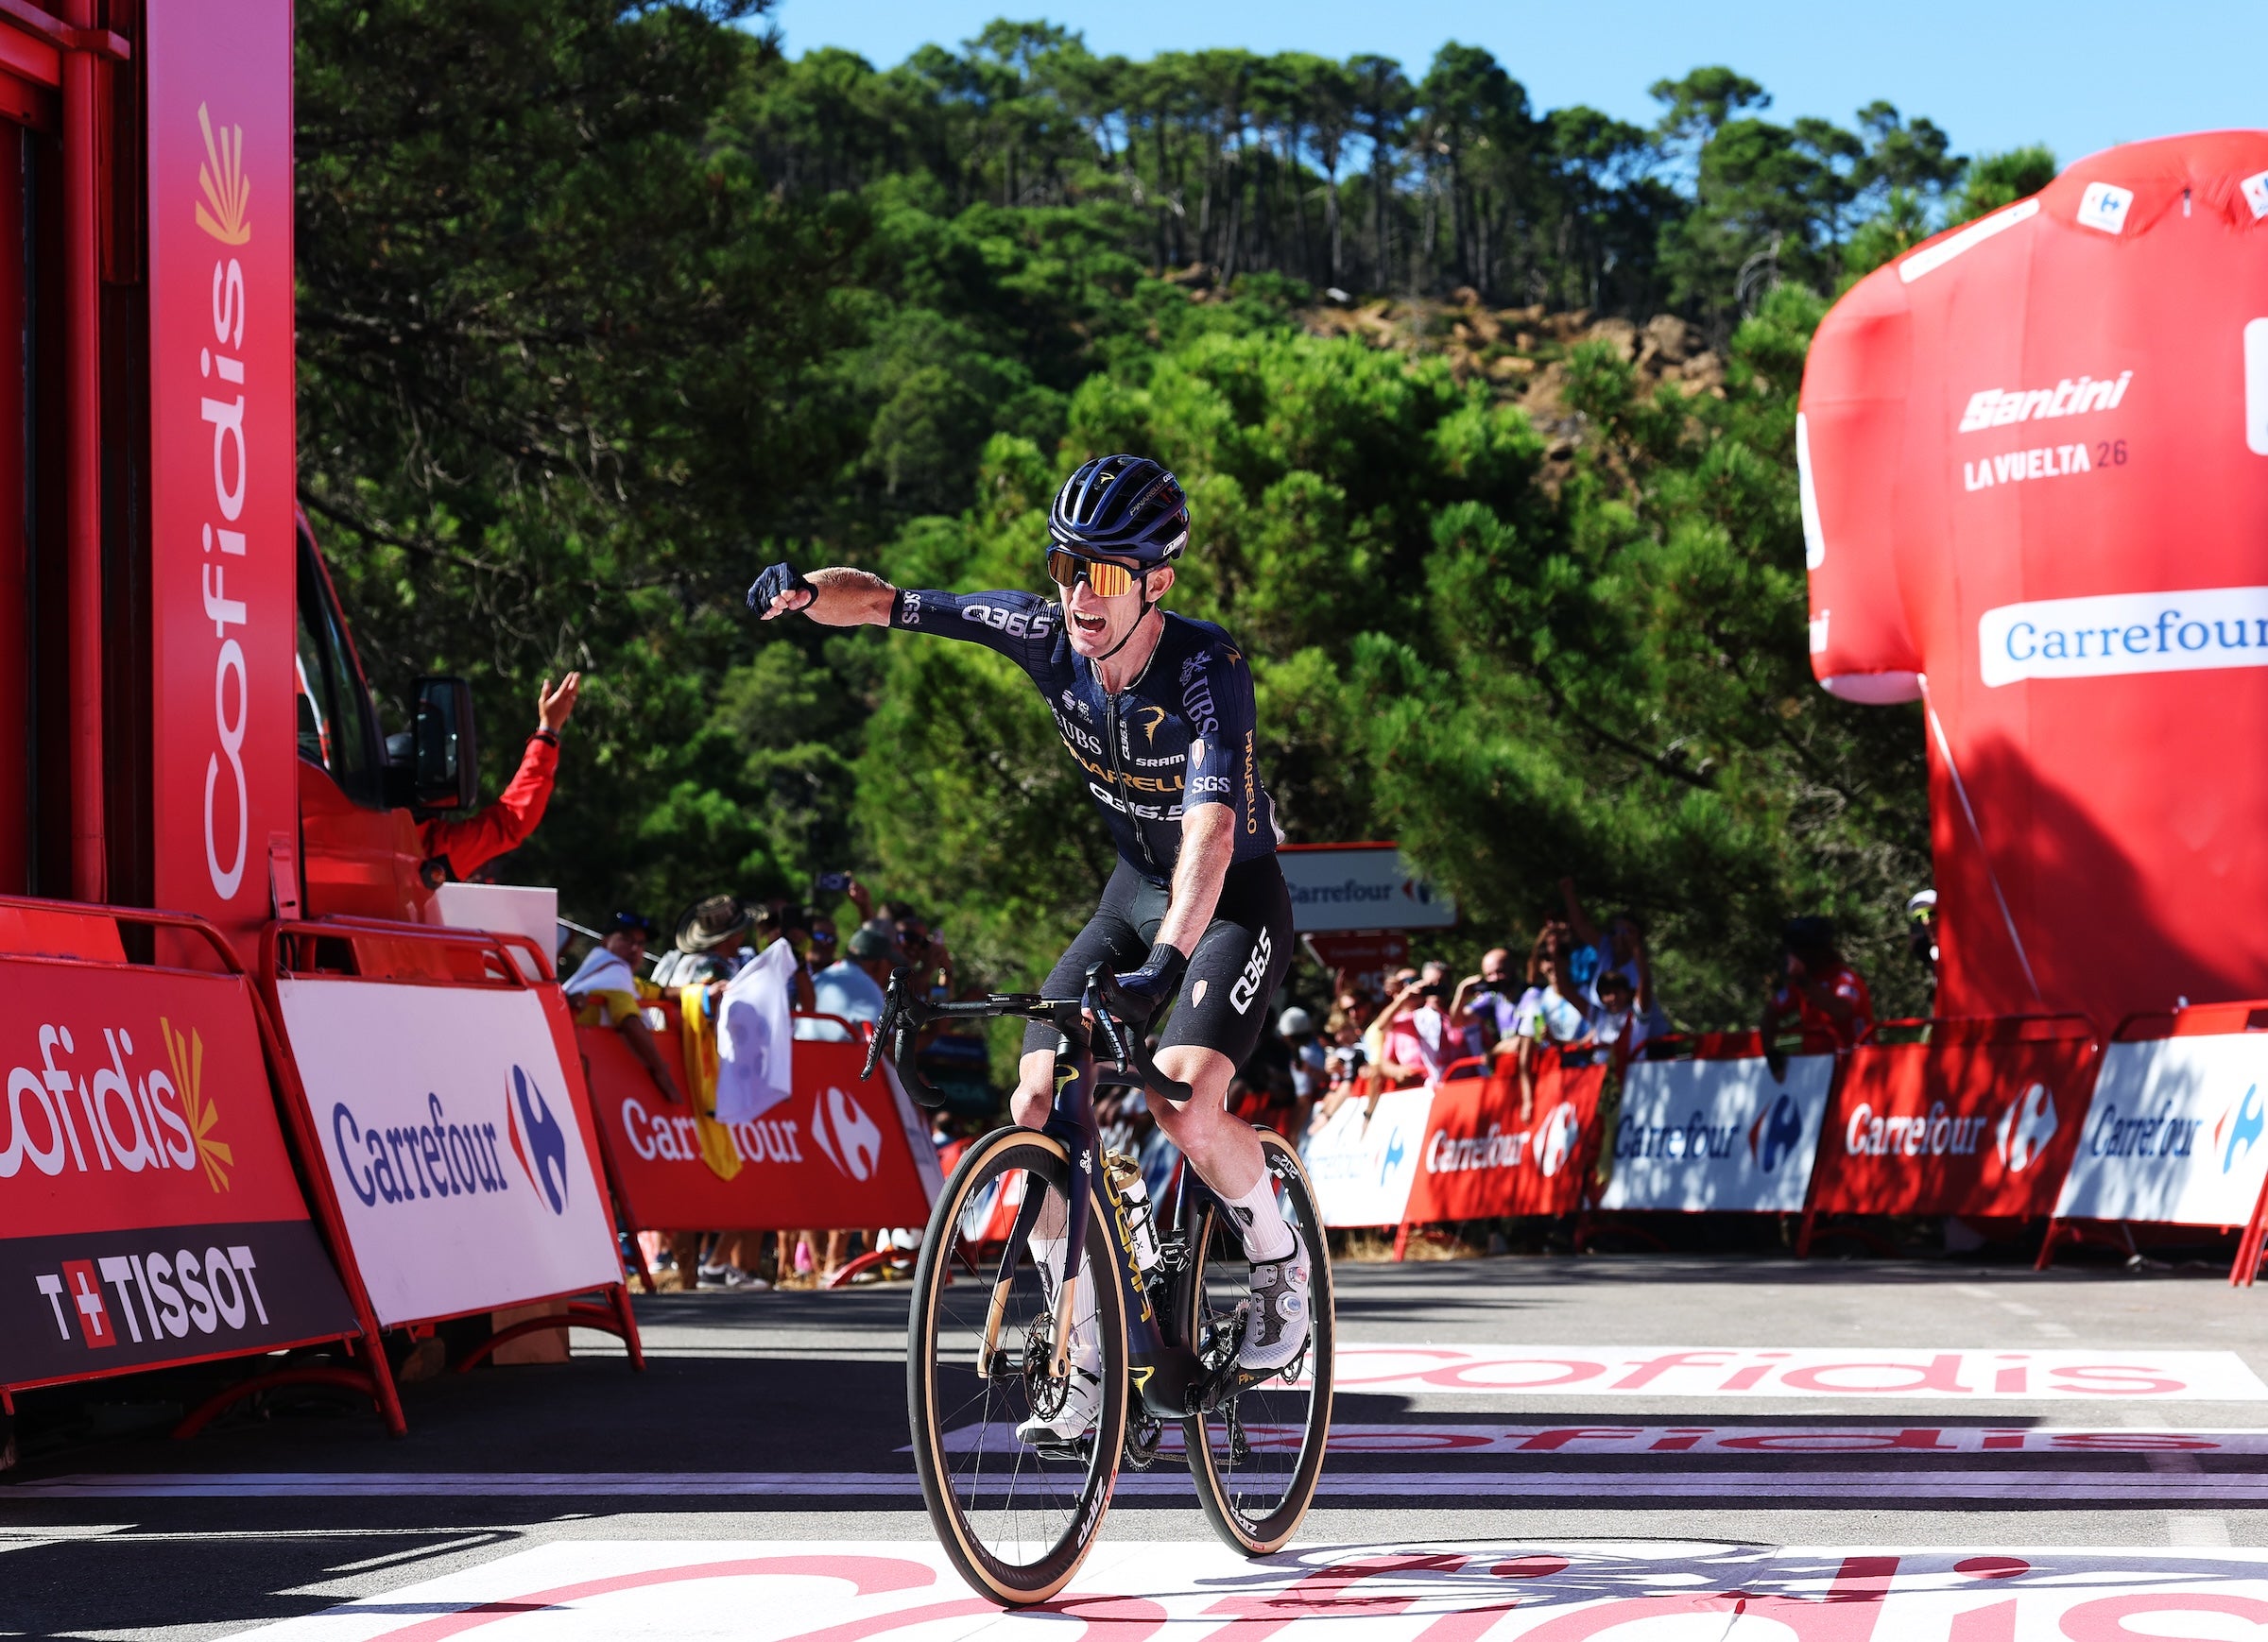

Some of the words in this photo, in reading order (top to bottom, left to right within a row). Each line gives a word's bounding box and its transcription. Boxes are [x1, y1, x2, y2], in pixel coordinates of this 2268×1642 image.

[1959, 369, 2134, 434] Santini
[1964, 459, 1995, 491] LA
[1994, 443, 2091, 485] VUELTA
[2096, 439, 2128, 469] 26
[200, 258, 248, 900] Cofidis
[901, 590, 921, 624] SGS
[1182, 675, 1219, 734] UBS
[1060, 714, 1103, 755] UBS
[1136, 753, 1186, 767] SRAM
[1192, 776, 1230, 794] SGS
[1245, 728, 1258, 835] PINARELLO
[1286, 879, 1394, 904] arrefour
[0, 1023, 196, 1178] ofidis
[2091, 1100, 2204, 1156] Carrefour
[333, 1092, 508, 1207] Carrefour
[622, 1098, 803, 1163] Carour
[1426, 1122, 1531, 1174] Carrefour
[1615, 1110, 1741, 1159] Carrefour
[1846, 1101, 1987, 1156] Carrefour
[97, 1245, 269, 1343] TISSOT
